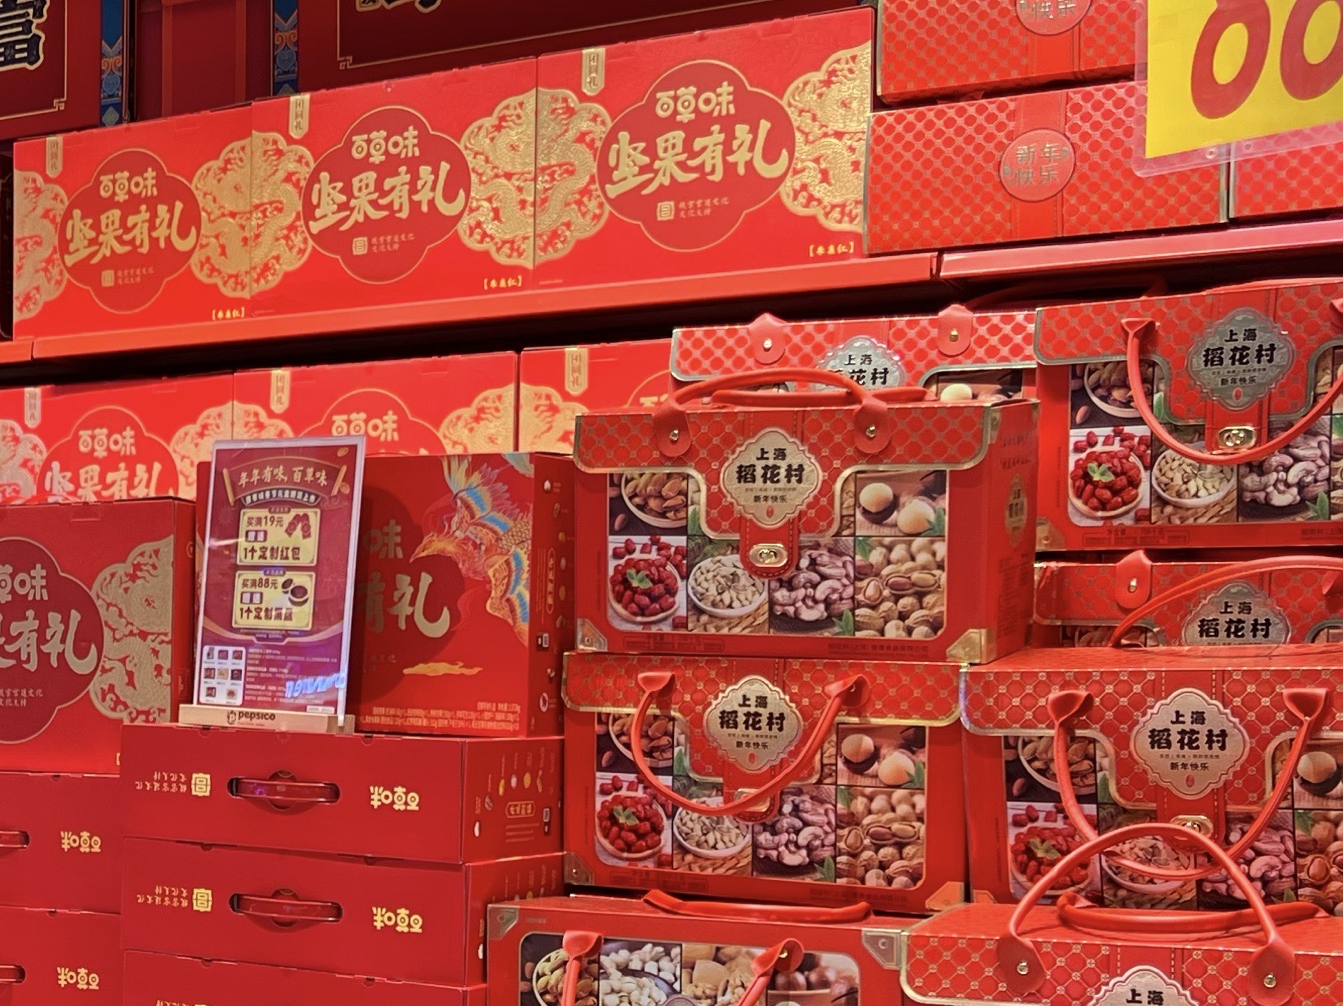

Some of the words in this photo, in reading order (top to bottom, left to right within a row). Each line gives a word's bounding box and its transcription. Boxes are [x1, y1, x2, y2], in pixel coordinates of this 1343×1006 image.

[655, 81, 735, 123] 百草味
[352, 126, 419, 164] 百草味
[605, 119, 789, 198] 坚果有礼
[99, 168, 157, 202] 百草味
[308, 161, 466, 235] 坚果有礼
[64, 201, 197, 268] 坚果有礼
[1224, 328, 1257, 342] 上海
[1202, 343, 1276, 367] 稻花村
[332, 409, 399, 443] 百草味
[79, 427, 136, 459] 百草味
[755, 447, 787, 462] 上海
[736, 463, 805, 485] 稻花村
[244, 545, 300, 560] 1个定制红包
[1219, 601, 1252, 615] 上海
[1198, 617, 1272, 639] 稻花村
[738, 695, 768, 709] 上海
[718, 711, 785, 732] 稻花村
[1170, 710, 1207, 726] 上海
[1147, 728, 1228, 751] 稻花村
[1170, 761, 1210, 772] 新年快乐
[370, 785, 419, 811] 百草味
[60, 831, 102, 854] 百草味
[372, 906, 423, 933] 百草味
[57, 967, 100, 990] 百草味
[1126, 988, 1164, 1006] 上海
